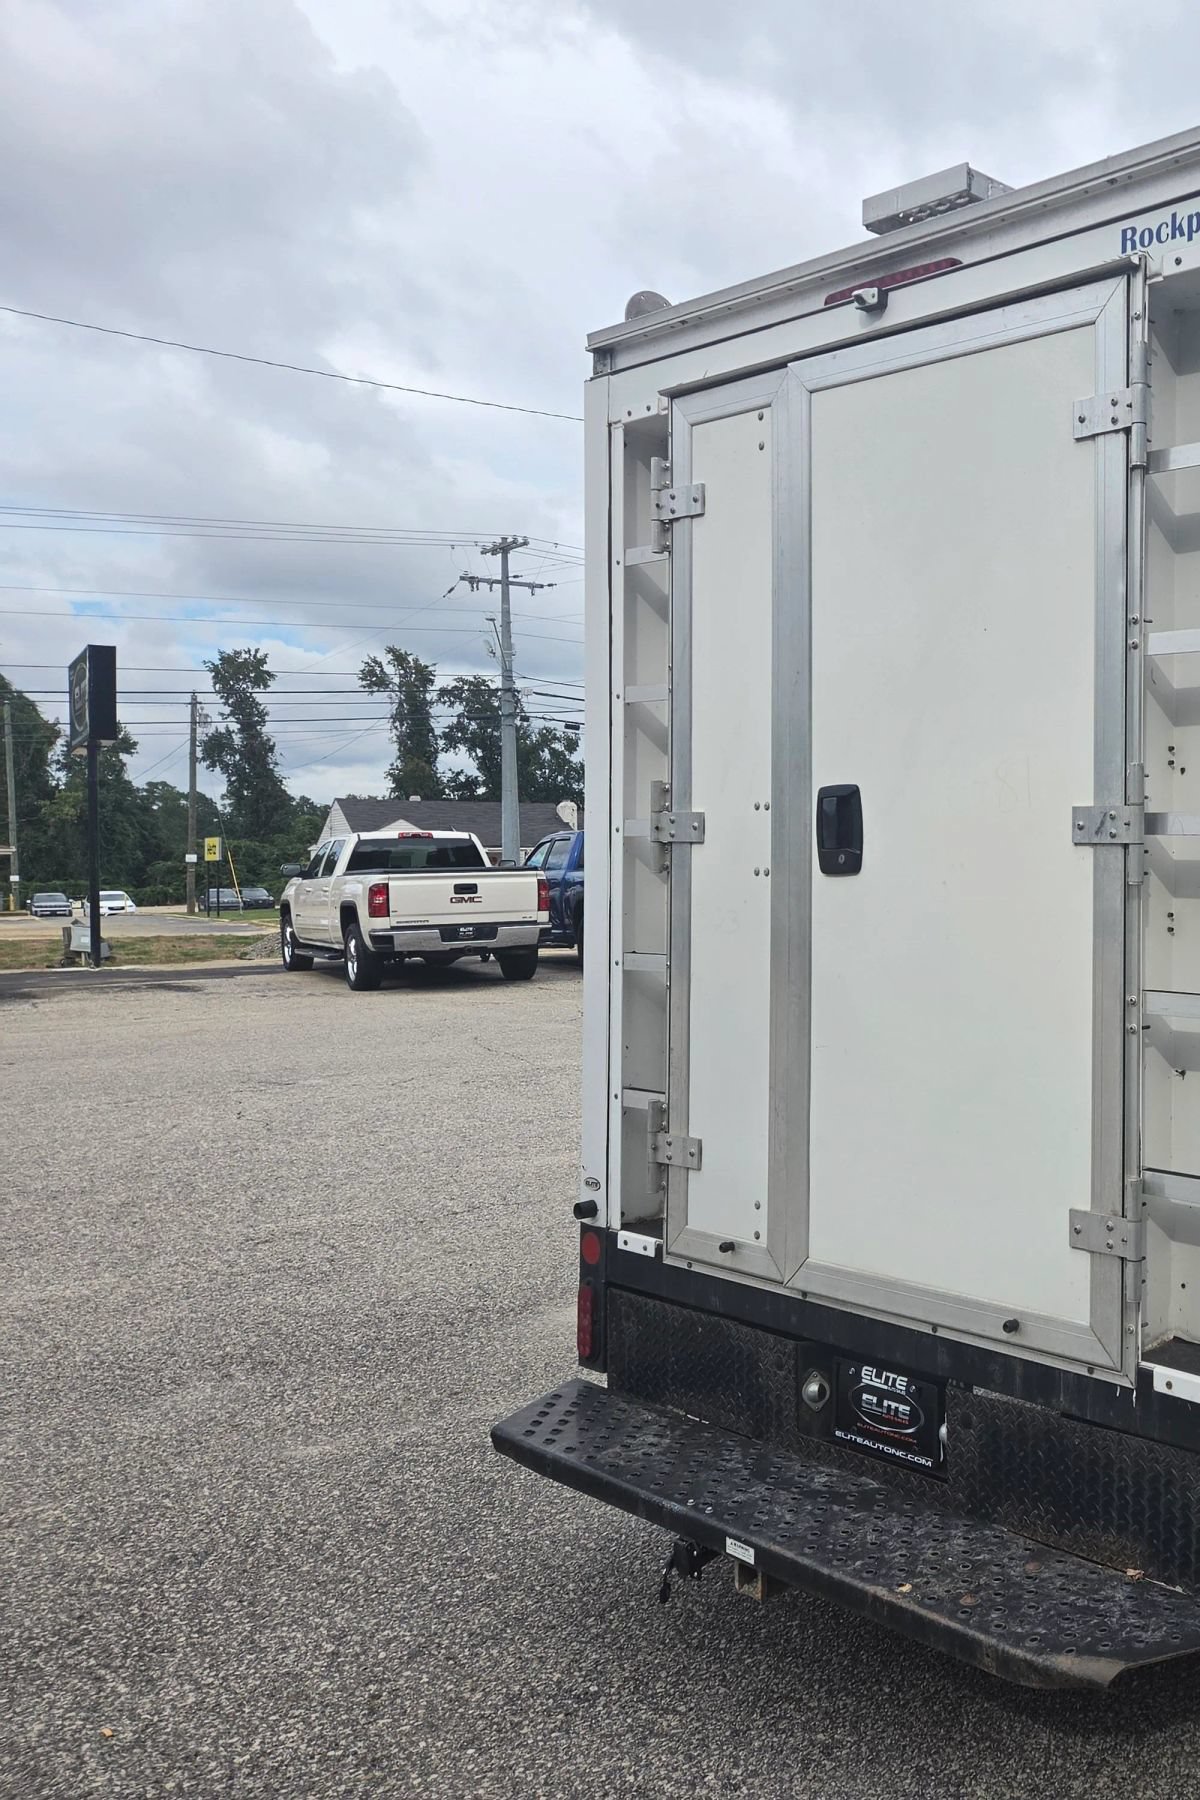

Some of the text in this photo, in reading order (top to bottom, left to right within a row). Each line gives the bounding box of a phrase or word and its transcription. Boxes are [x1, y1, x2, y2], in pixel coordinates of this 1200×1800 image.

[450, 896, 483, 904] GMC
[861, 1365, 908, 1391] ELITE
[861, 1393, 911, 1420] ELITE
[835, 1430, 932, 1467] ELITEAUTONC.COM
